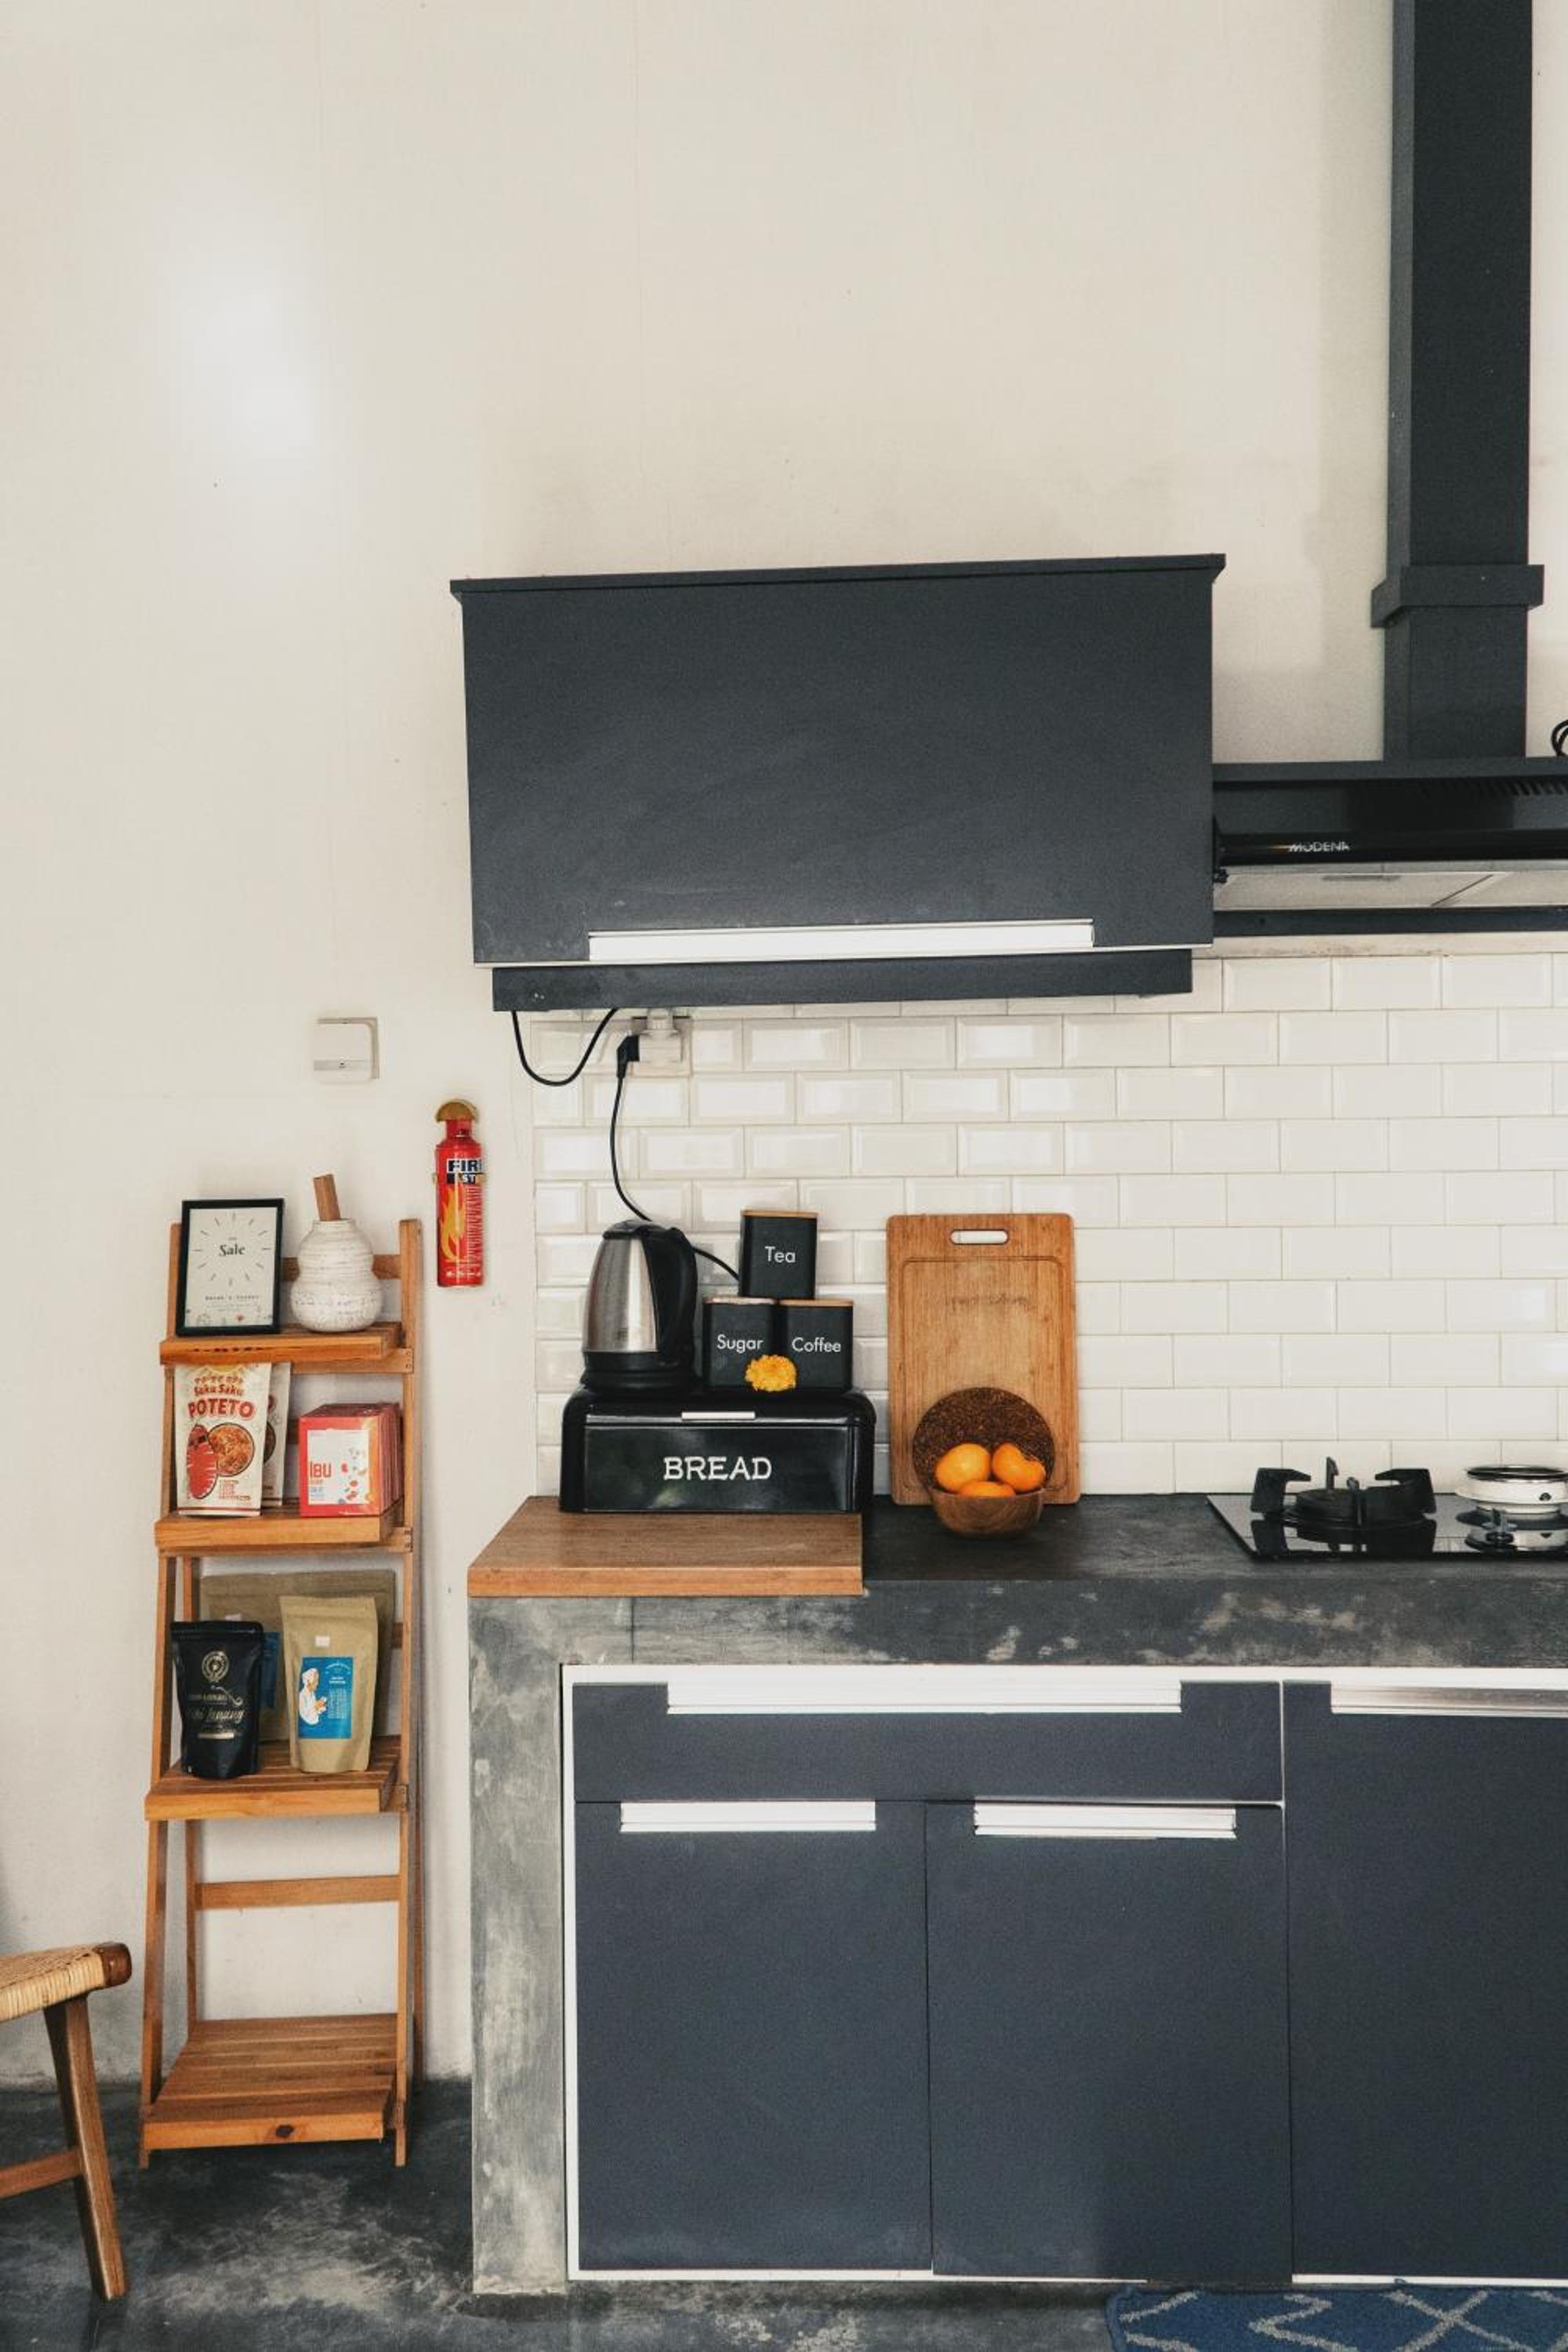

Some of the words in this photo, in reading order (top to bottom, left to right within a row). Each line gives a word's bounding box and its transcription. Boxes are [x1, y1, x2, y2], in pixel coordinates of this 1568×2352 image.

[1287, 841, 1350, 852] MODENA
[219, 1243, 245, 1258] Sale
[764, 1246, 796, 1263] Tea
[717, 1334, 764, 1353] Sugar
[791, 1337, 841, 1352] Coffee
[188, 1398, 255, 1419] POTETO
[663, 1456, 772, 1480] BREAD
